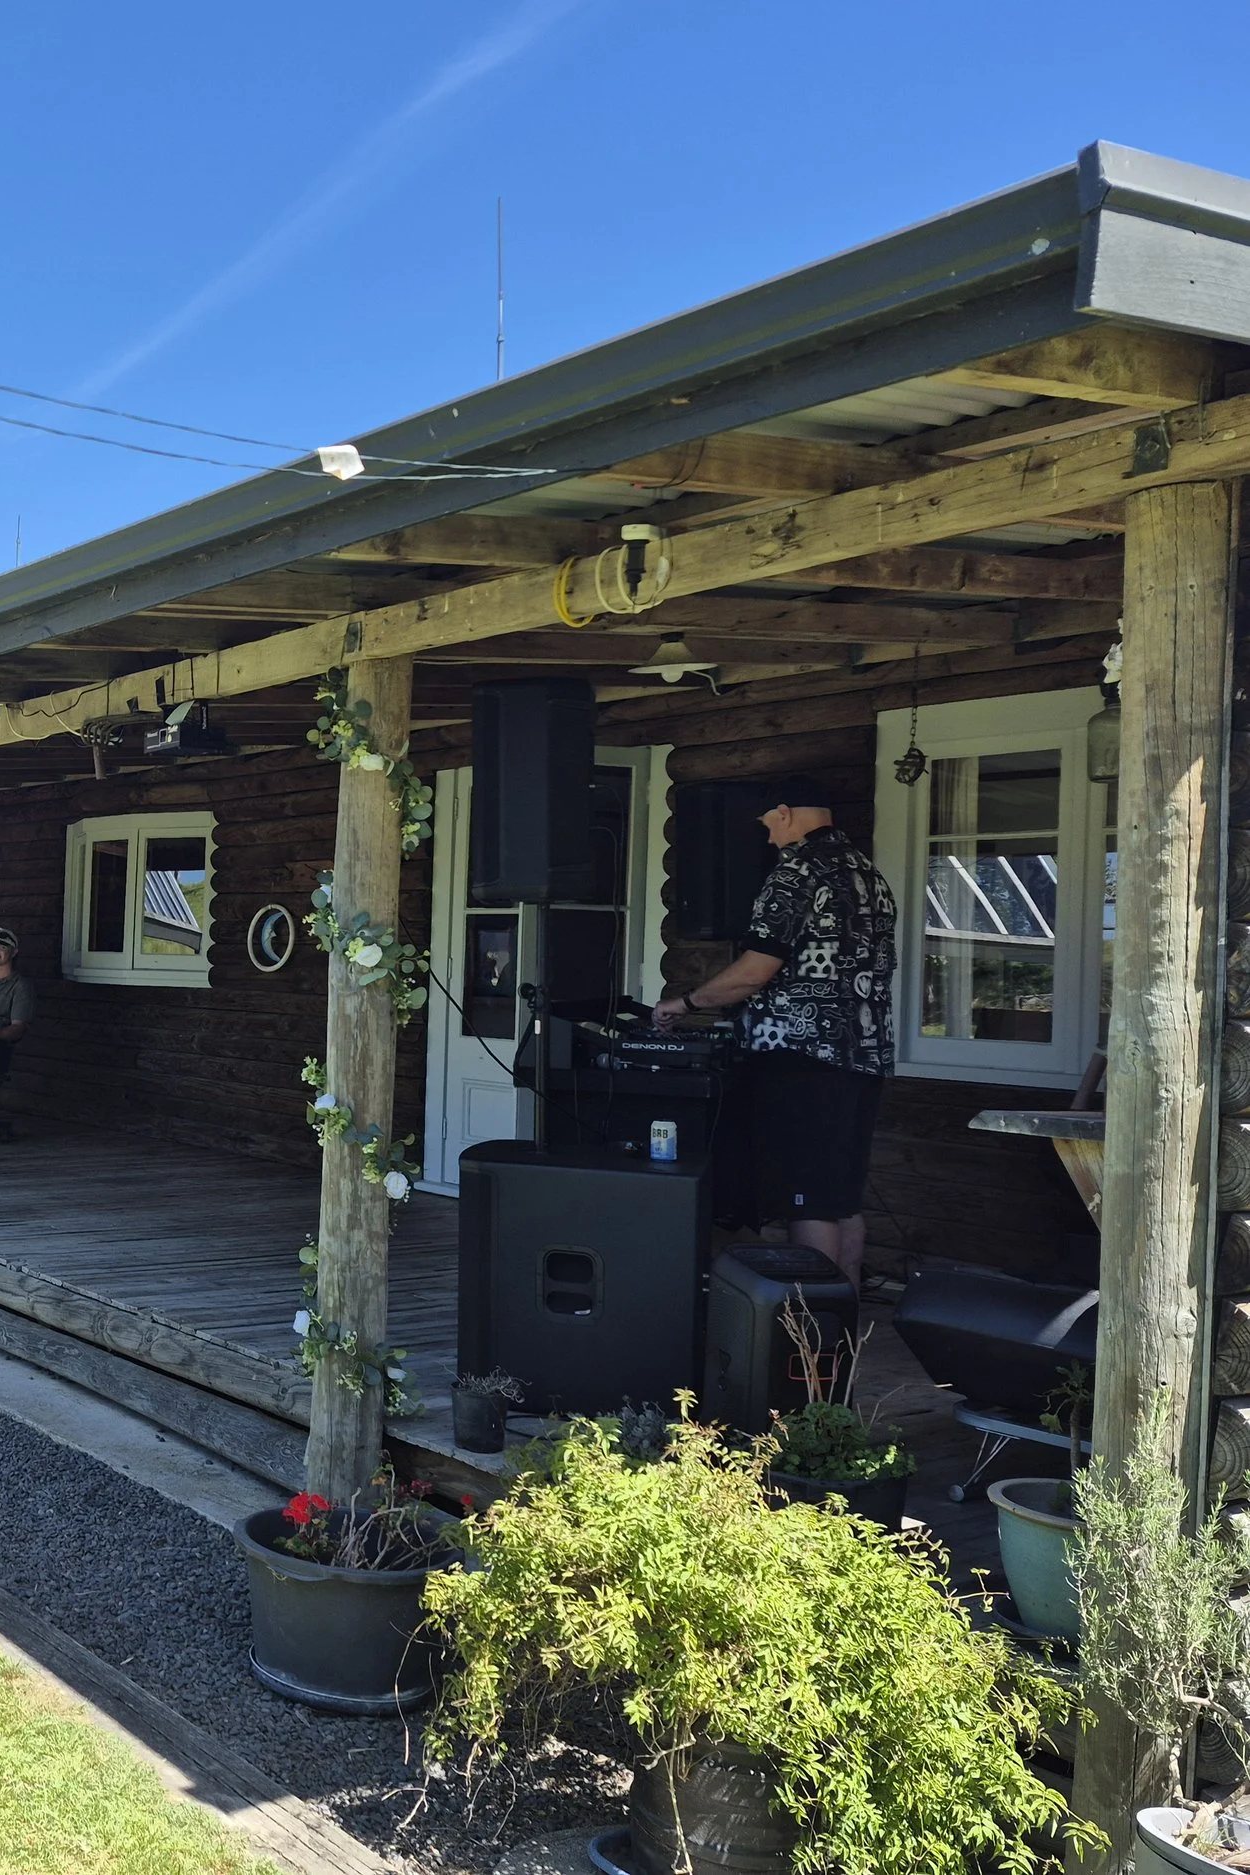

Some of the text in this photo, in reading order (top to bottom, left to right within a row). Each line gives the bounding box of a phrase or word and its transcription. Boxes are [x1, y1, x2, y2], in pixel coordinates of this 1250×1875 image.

[622, 1042, 685, 1052] DENON DJ
[652, 1127, 669, 1139] BRB
